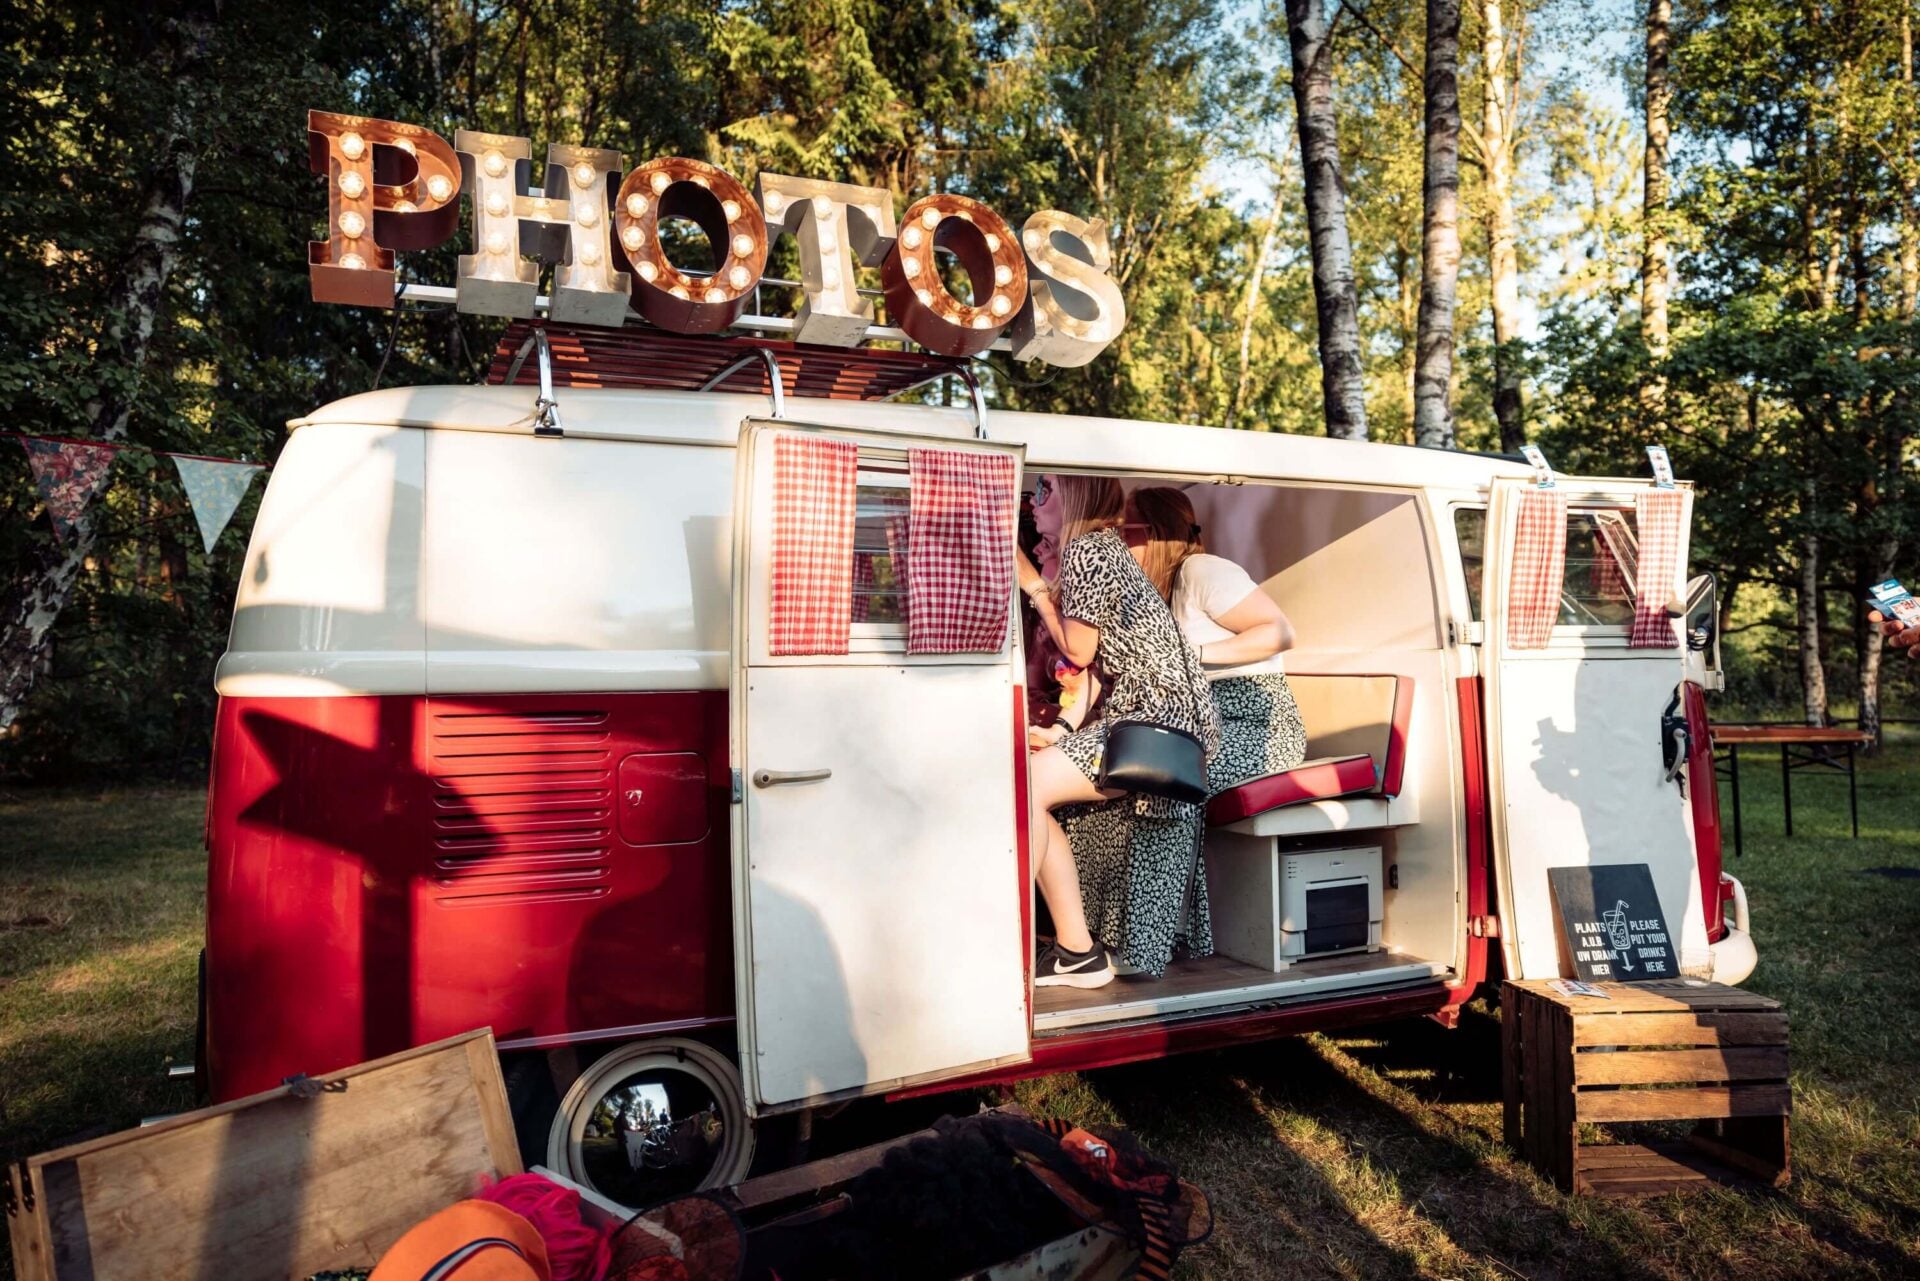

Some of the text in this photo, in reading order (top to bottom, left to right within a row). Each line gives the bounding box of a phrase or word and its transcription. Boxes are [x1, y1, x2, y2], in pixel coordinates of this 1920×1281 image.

[308, 108, 1126, 367] PHOTOS
[1574, 923, 1607, 933] PLAATS
[1630, 920, 1660, 930] PLEASE
[1581, 936, 1606, 948] A.U.B.
[1630, 933, 1667, 945] PUT YOUR
[1576, 950, 1619, 962] UW DRANK
[1638, 947, 1666, 958] DRINKS
[1591, 964, 1611, 976] HIER
[1645, 961, 1666, 972] HERE
